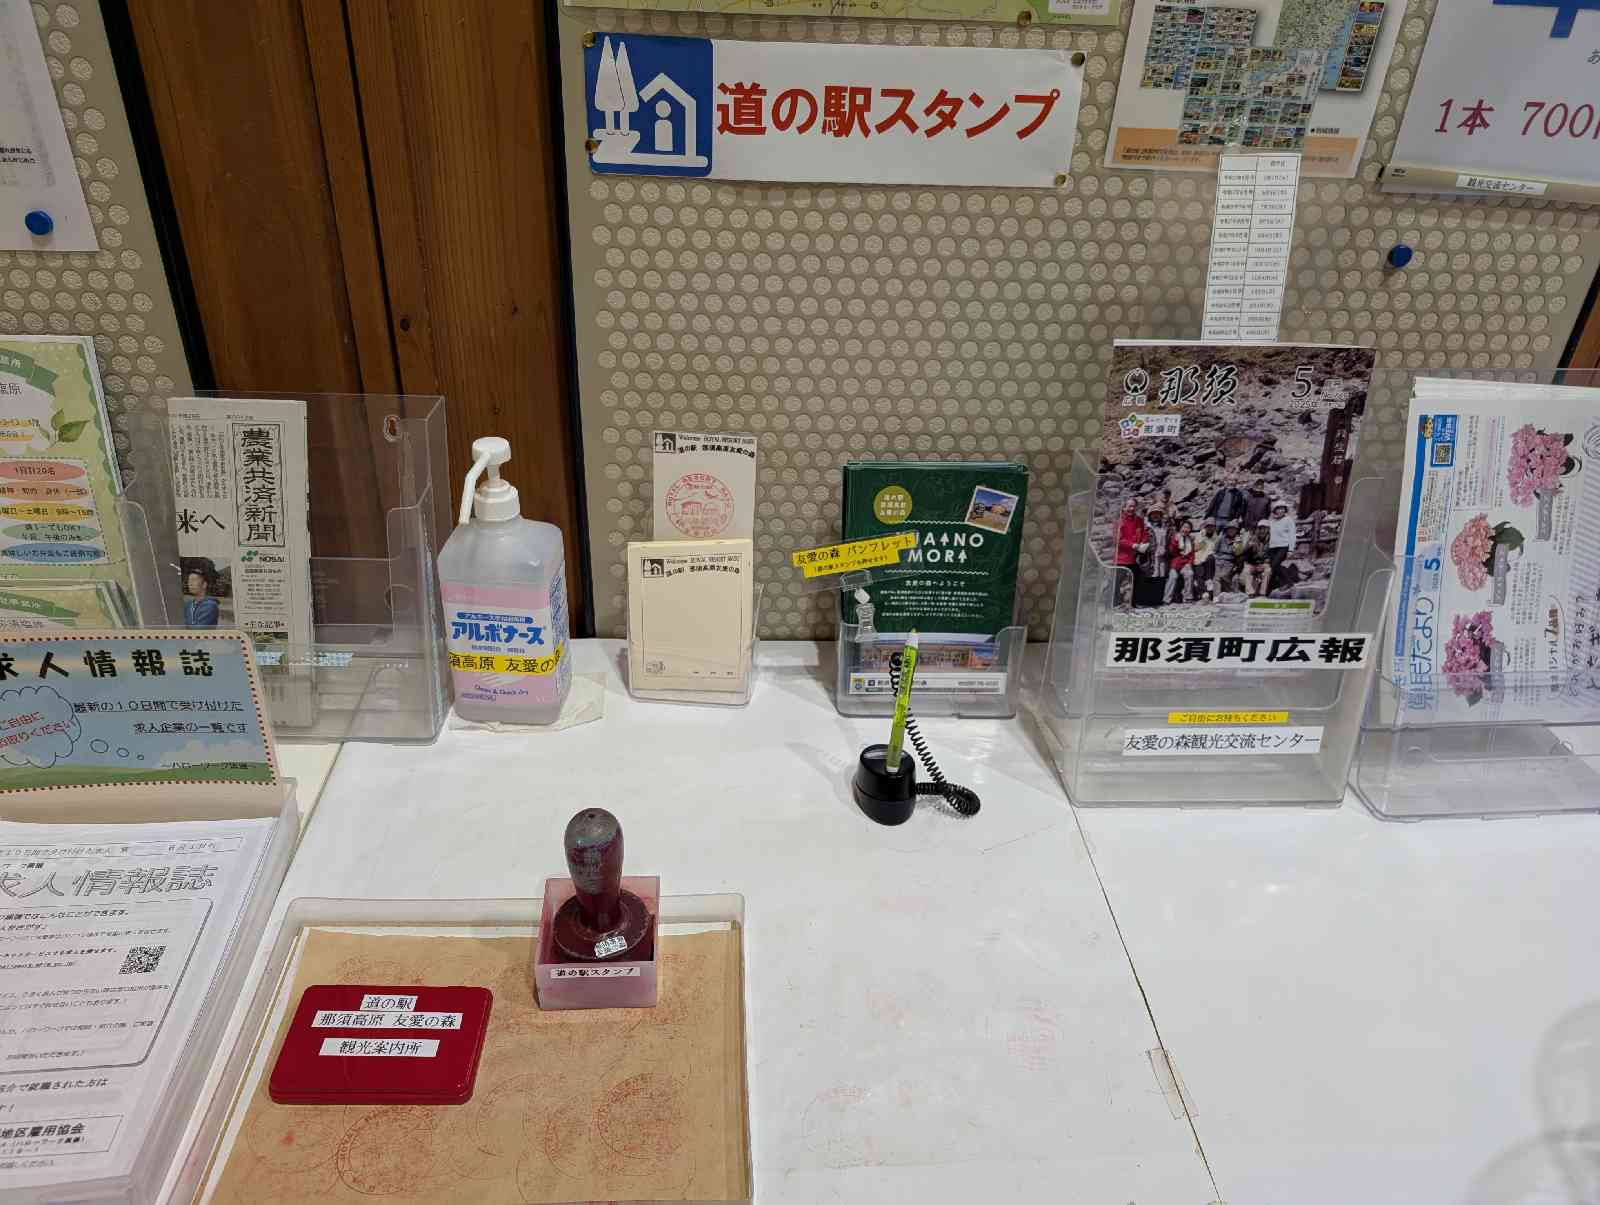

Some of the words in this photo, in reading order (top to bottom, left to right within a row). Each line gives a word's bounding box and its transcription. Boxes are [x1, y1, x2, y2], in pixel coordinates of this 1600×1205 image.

[716, 82, 1060, 140] 道の駅スタンプ
[1434, 98, 1495, 137] 1本
[1520, 101, 1600, 140] 700
[1466, 177, 1536, 193] 観光交流センター
[1159, 364, 1239, 406] 那須
[1291, 367, 1314, 400] 5
[240, 427, 279, 543] 農業共済新聞
[796, 548, 842, 565] 友愛の森
[847, 536, 914, 555] パンフレット
[451, 621, 545, 645] アルボナース
[1113, 636, 1366, 664] 那須町広報
[1125, 733, 1321, 751] 友愛の森観光交流センター
[556, 967, 634, 977] 道の駅スタンプ
[364, 996, 415, 1010] 道の駅
[318, 1012, 384, 1027] 那須高原
[391, 1013, 457, 1028] 友愛の森
[339, 1040, 424, 1055] 観光案内所
[0, 1123, 86, 1139] 地区雇用協会
